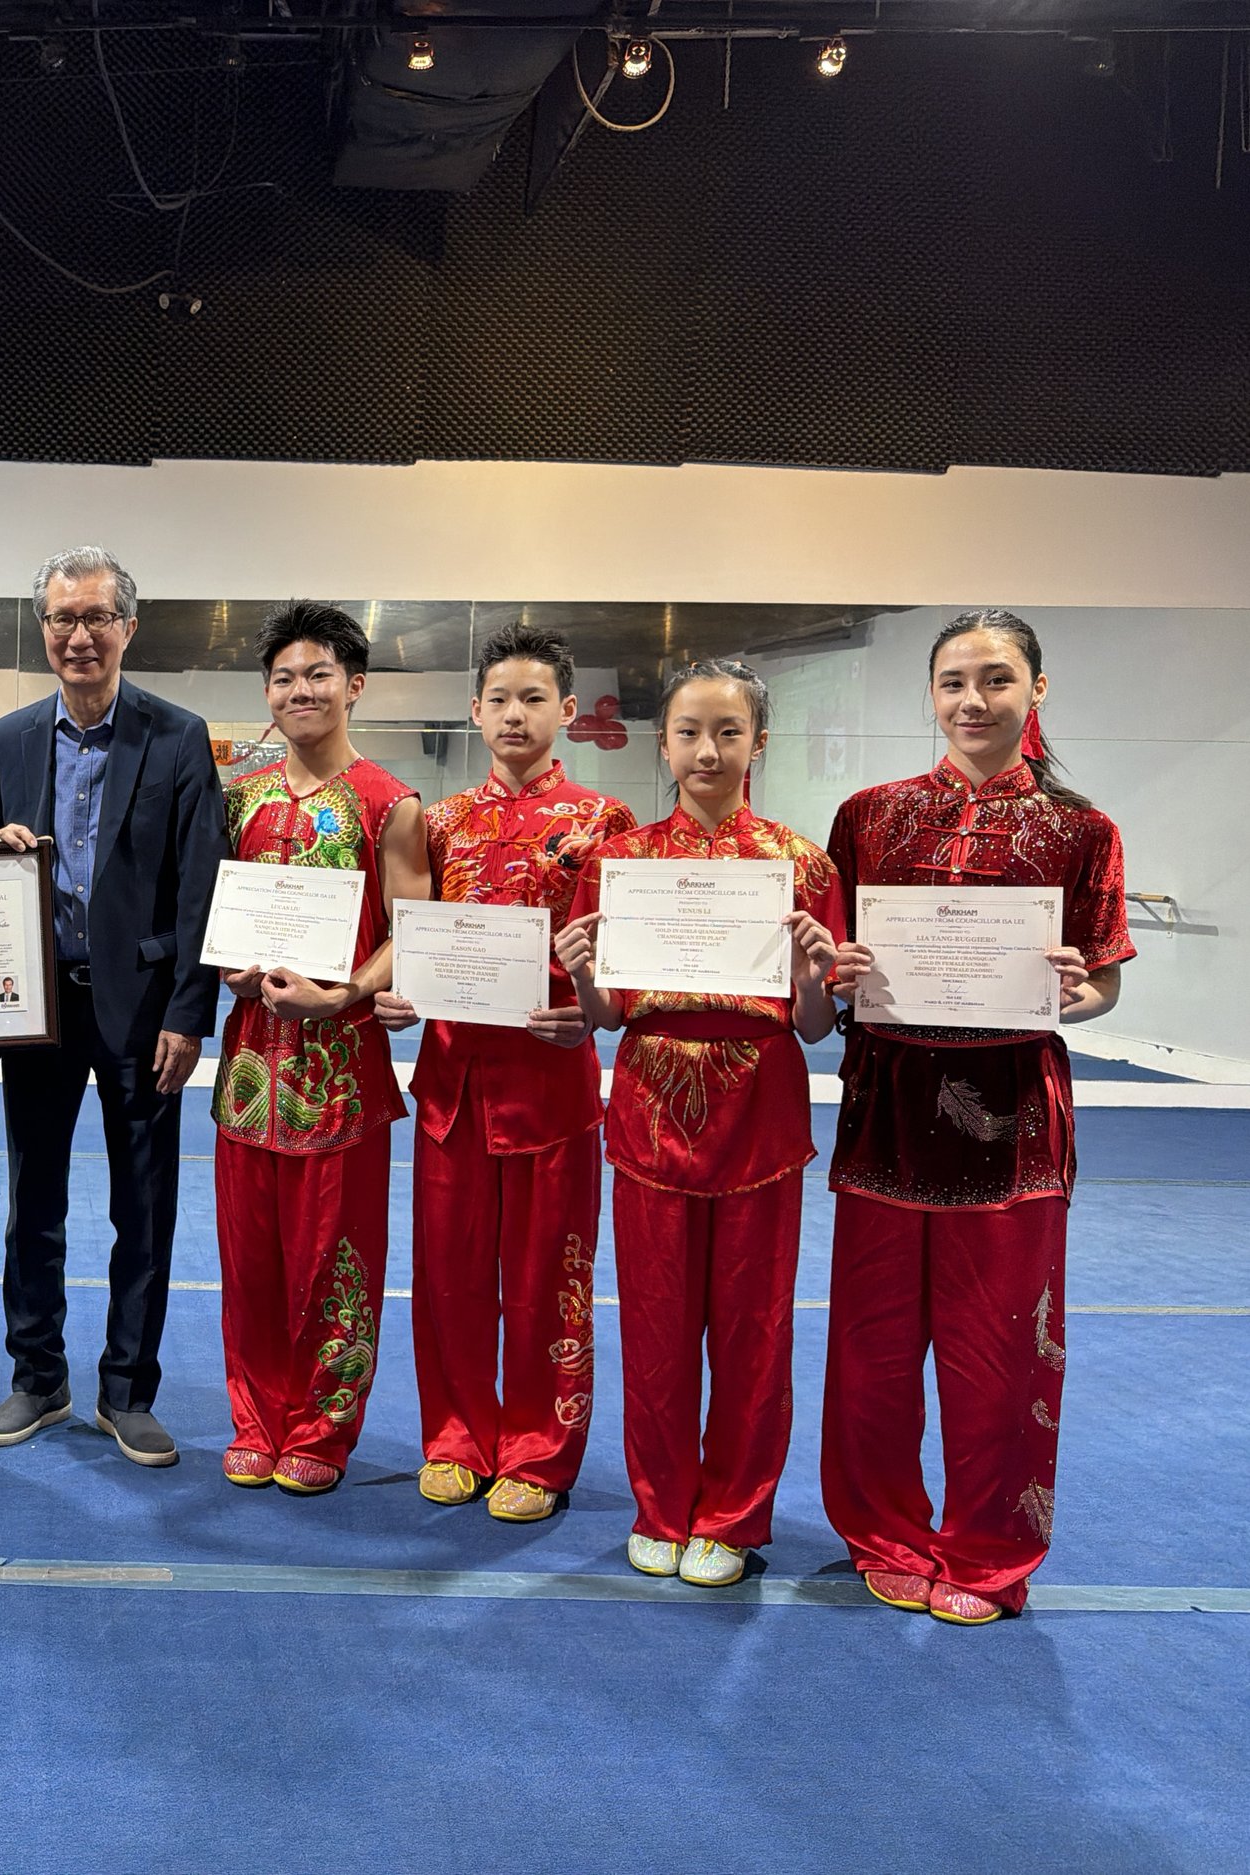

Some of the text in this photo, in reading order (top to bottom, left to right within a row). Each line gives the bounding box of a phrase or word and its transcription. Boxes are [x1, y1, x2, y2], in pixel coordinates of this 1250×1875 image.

[676, 878, 715, 889] MARKHAM
[937, 906, 978, 917] MARKHAM
[454, 919, 485, 929] MARKHAM
